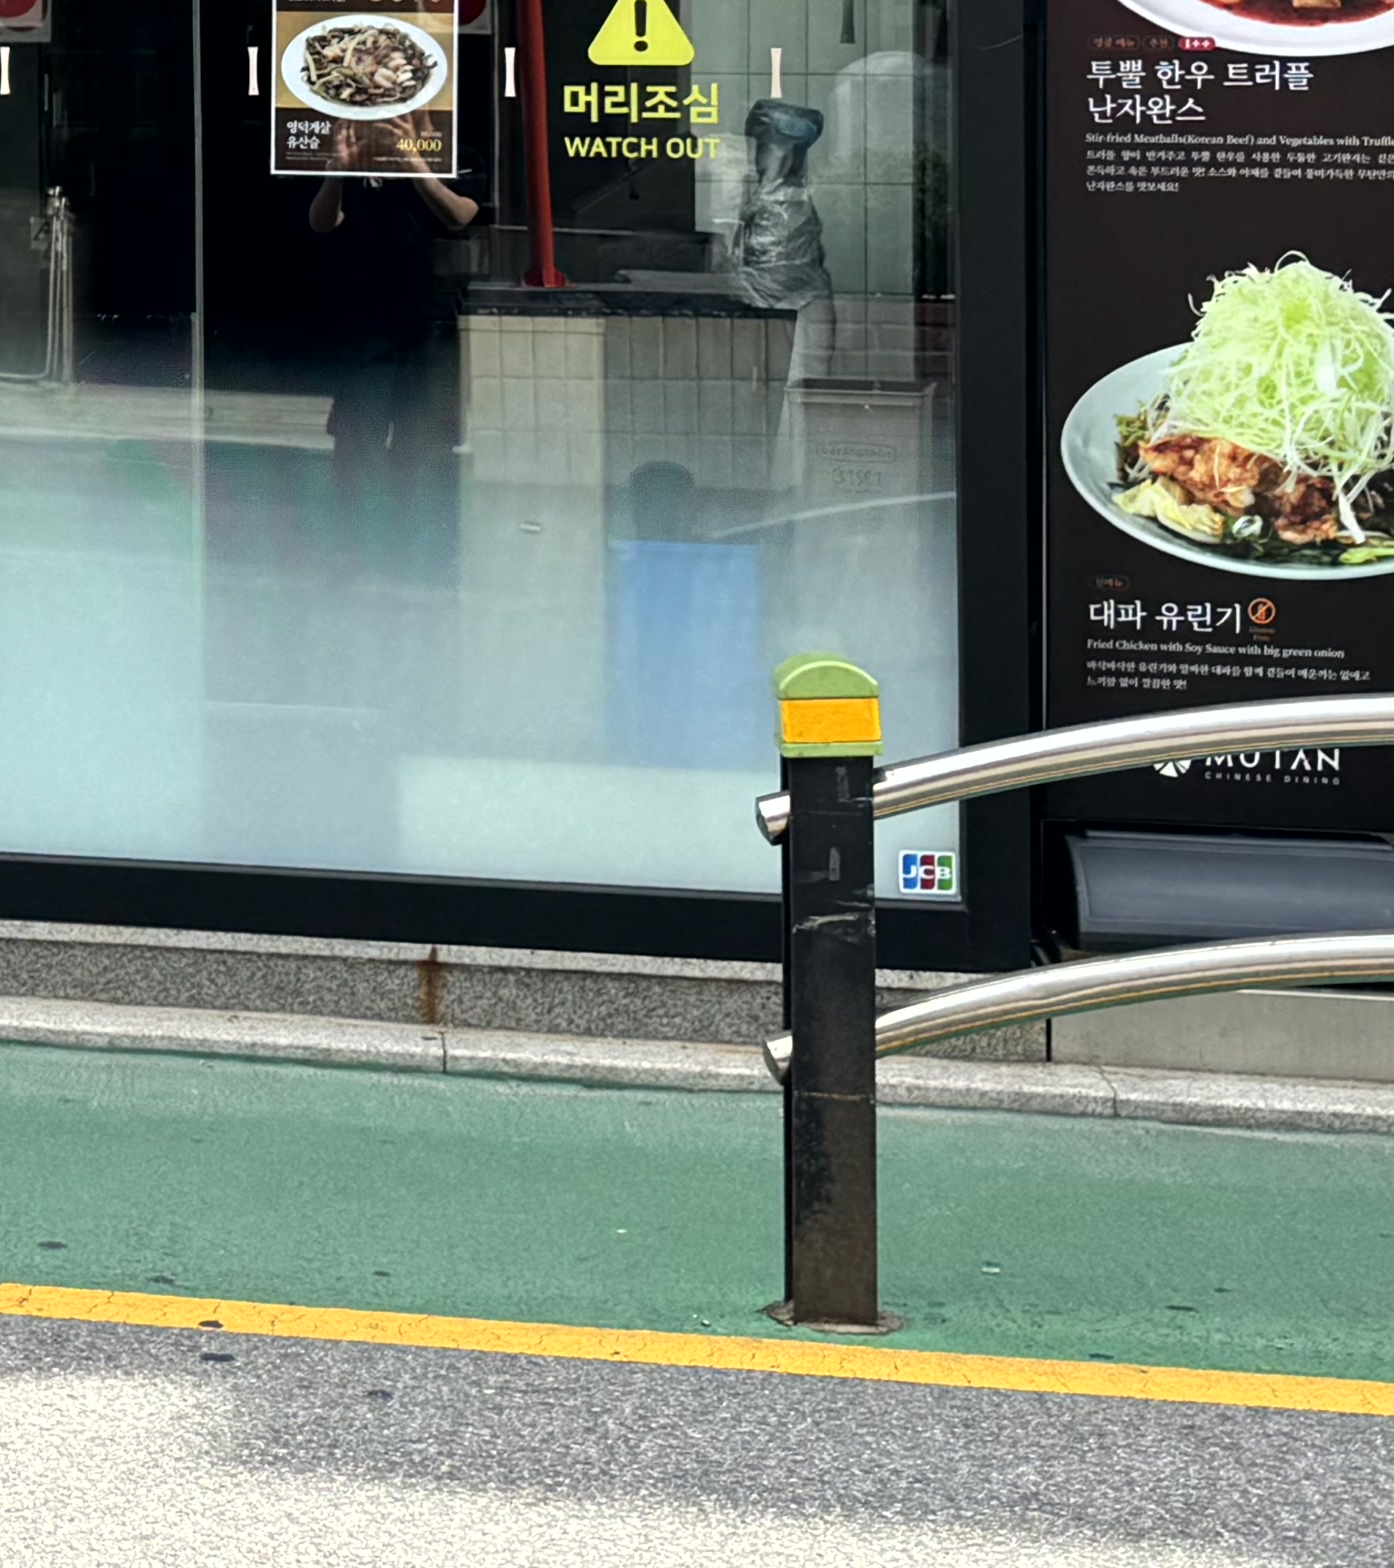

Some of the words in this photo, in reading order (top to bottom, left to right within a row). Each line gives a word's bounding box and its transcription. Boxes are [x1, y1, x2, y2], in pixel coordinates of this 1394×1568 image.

[1086, 60, 1146, 89] 투뿔
[1155, 59, 1215, 89] 한우
[1223, 60, 1314, 91] 트러플
[563, 82, 720, 123] 머리조심
[1087, 94, 1206, 124] 난자완스
[564, 137, 658, 159] WATCH
[666, 137, 720, 159] OUT
[1256, 135, 1277, 145] and
[1278, 136, 1335, 147] Vegetables
[1336, 135, 1360, 146] with
[1089, 599, 1146, 629] 대파
[1155, 602, 1241, 634] 유린기
[1087, 639, 1113, 649] Fried
[1116, 640, 1158, 651] Chicken
[1160, 642, 1183, 651] with
[1185, 642, 1203, 655] Soy
[1205, 644, 1236, 654] Sauce
[1238, 644, 1261, 655] with
[1264, 645, 1280, 658] big
[1282, 648, 1312, 659] green
[903, 865, 952, 879] JCB
